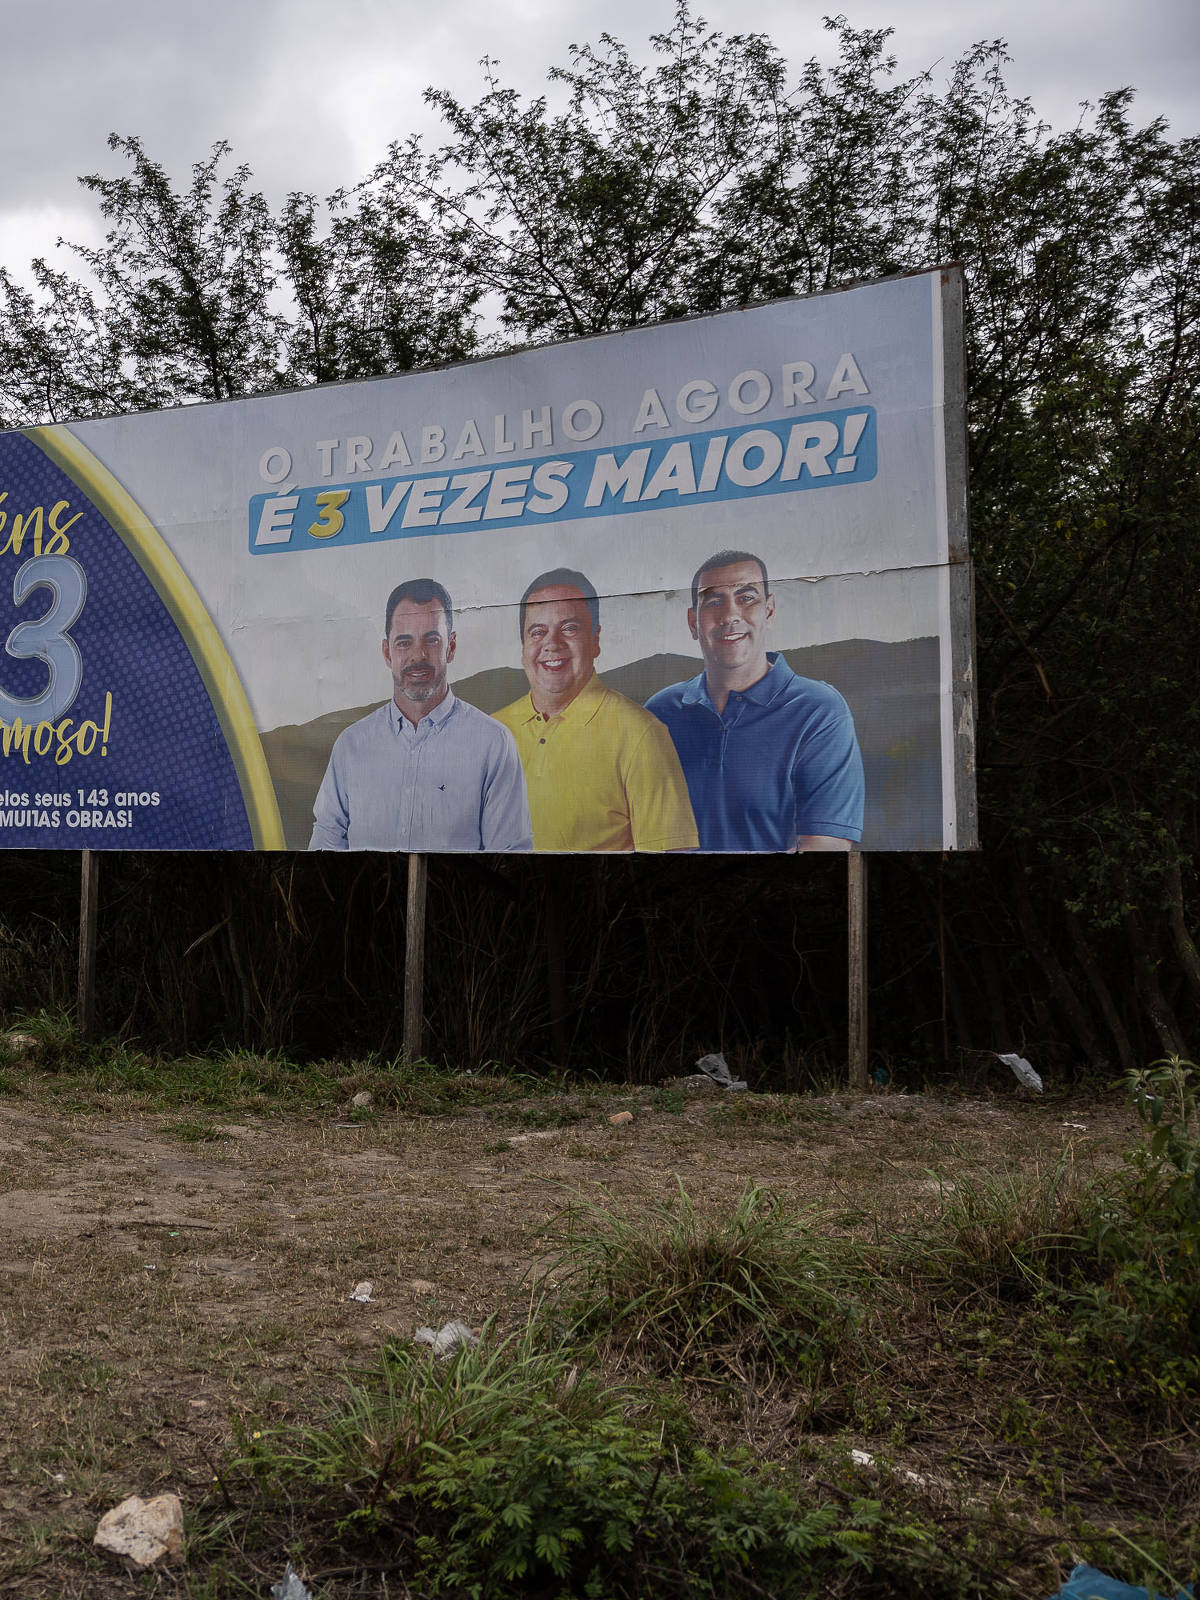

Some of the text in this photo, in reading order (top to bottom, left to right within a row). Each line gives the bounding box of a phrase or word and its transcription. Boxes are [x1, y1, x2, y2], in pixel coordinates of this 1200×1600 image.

[258, 352, 871, 484] O TRABALHO AGORA
[254, 412, 870, 547] É 3 VEZES MAIOR!
[0, 810, 61, 827] MUITAS
[65, 809, 133, 828] OBRAS!
[34, 792, 72, 807] seus
[77, 788, 109, 807] 143
[114, 791, 161, 806] anos
